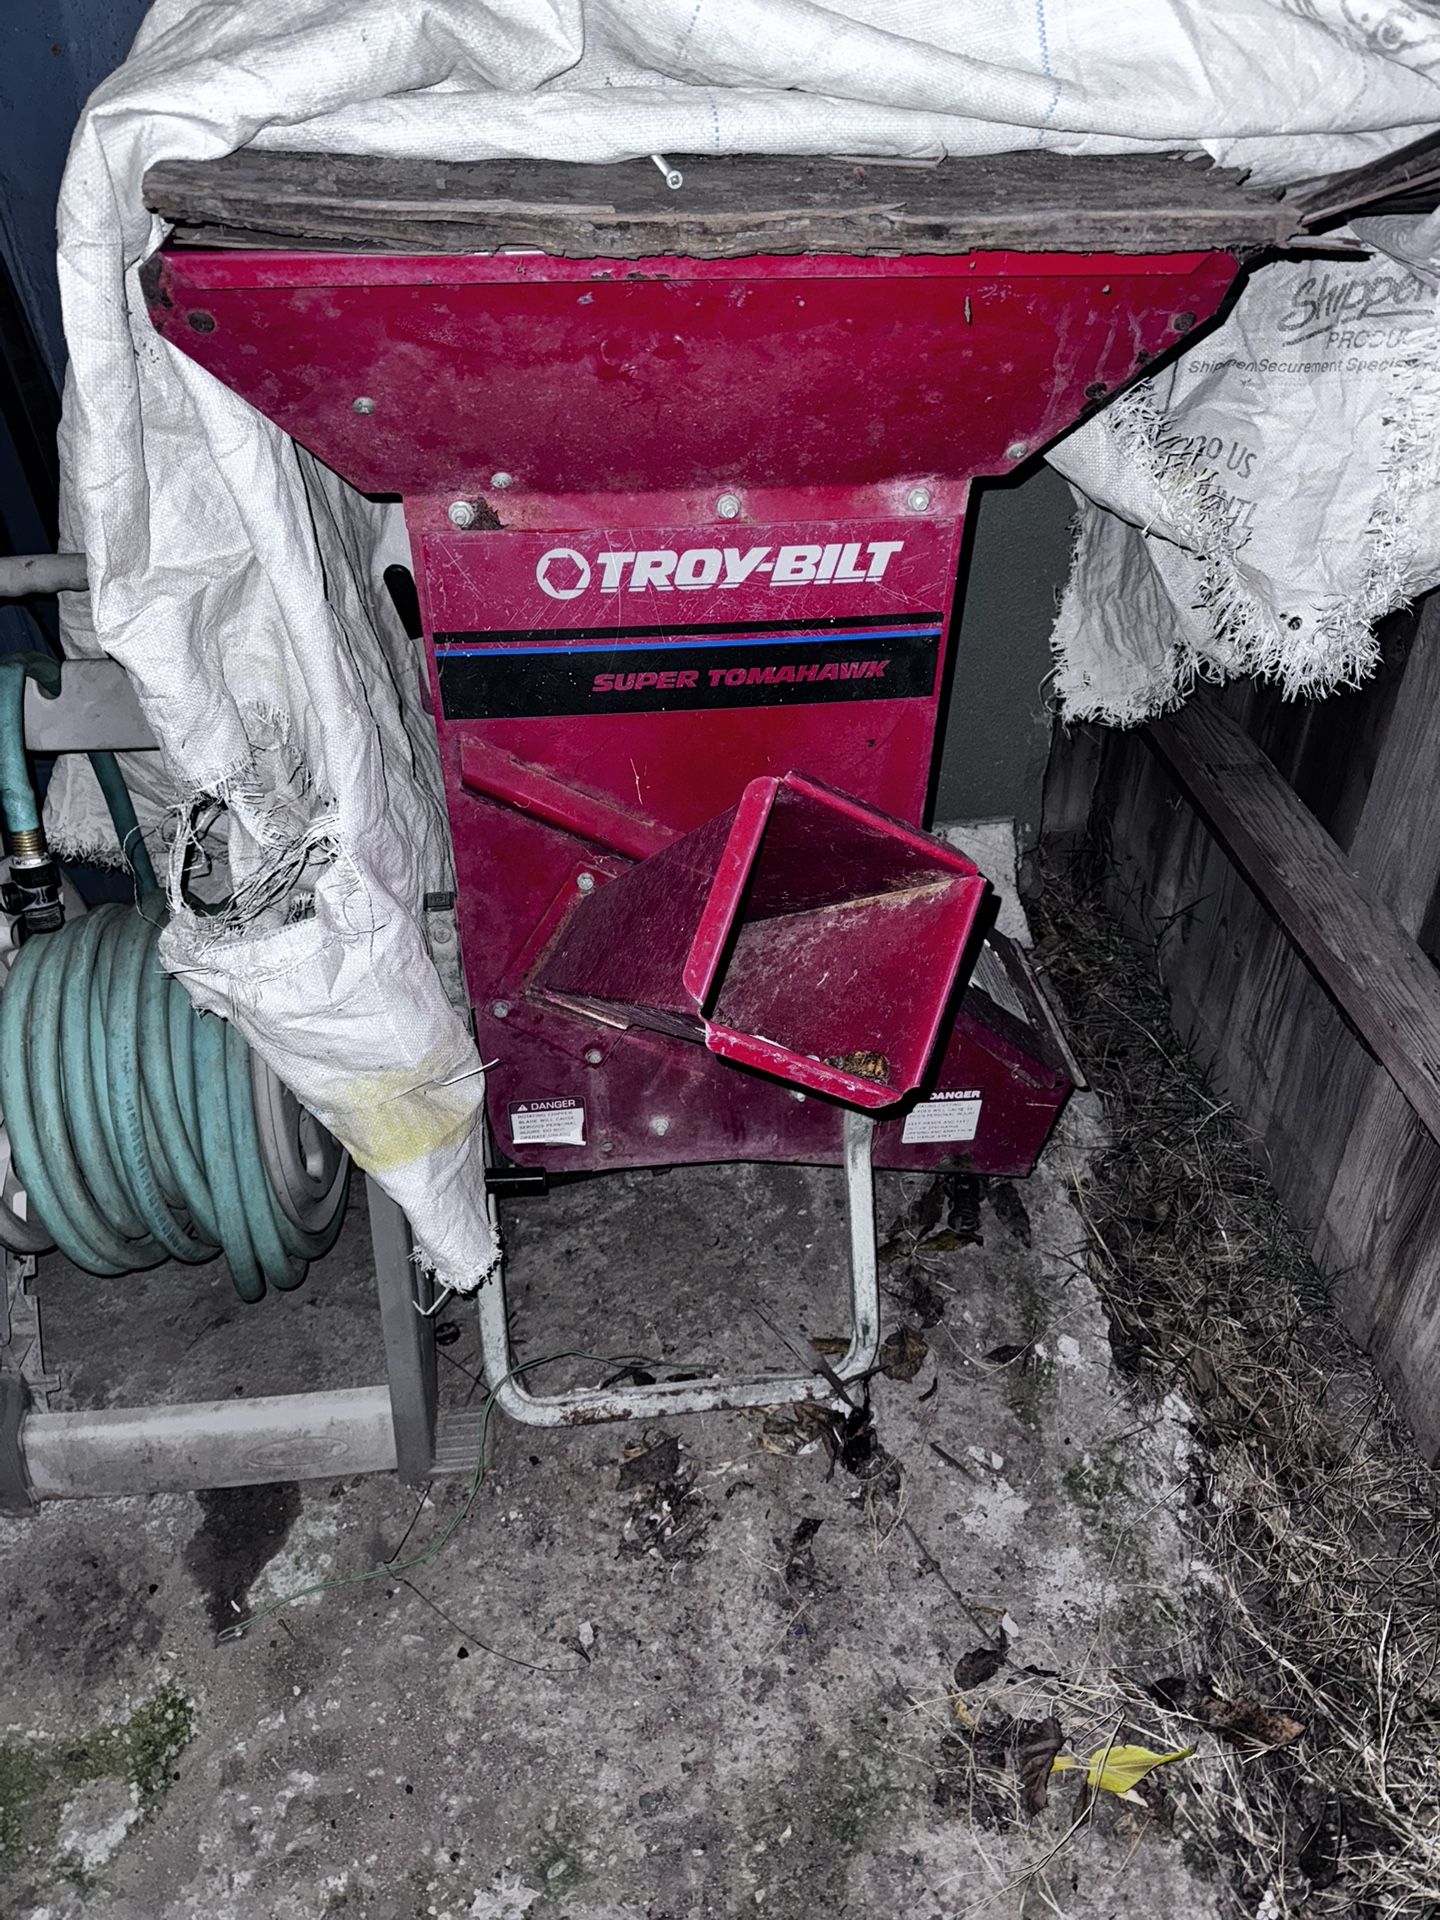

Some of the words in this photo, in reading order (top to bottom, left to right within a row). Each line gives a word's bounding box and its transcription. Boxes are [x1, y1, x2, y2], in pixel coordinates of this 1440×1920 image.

[1258, 358, 1344, 373] Securement
[1226, 441, 1258, 479] US
[596, 541, 905, 593] TROY-BILT
[592, 670, 699, 692] SUPER
[707, 660, 891, 687] TOMAHAWK
[531, 1100, 576, 1111] DANGER
